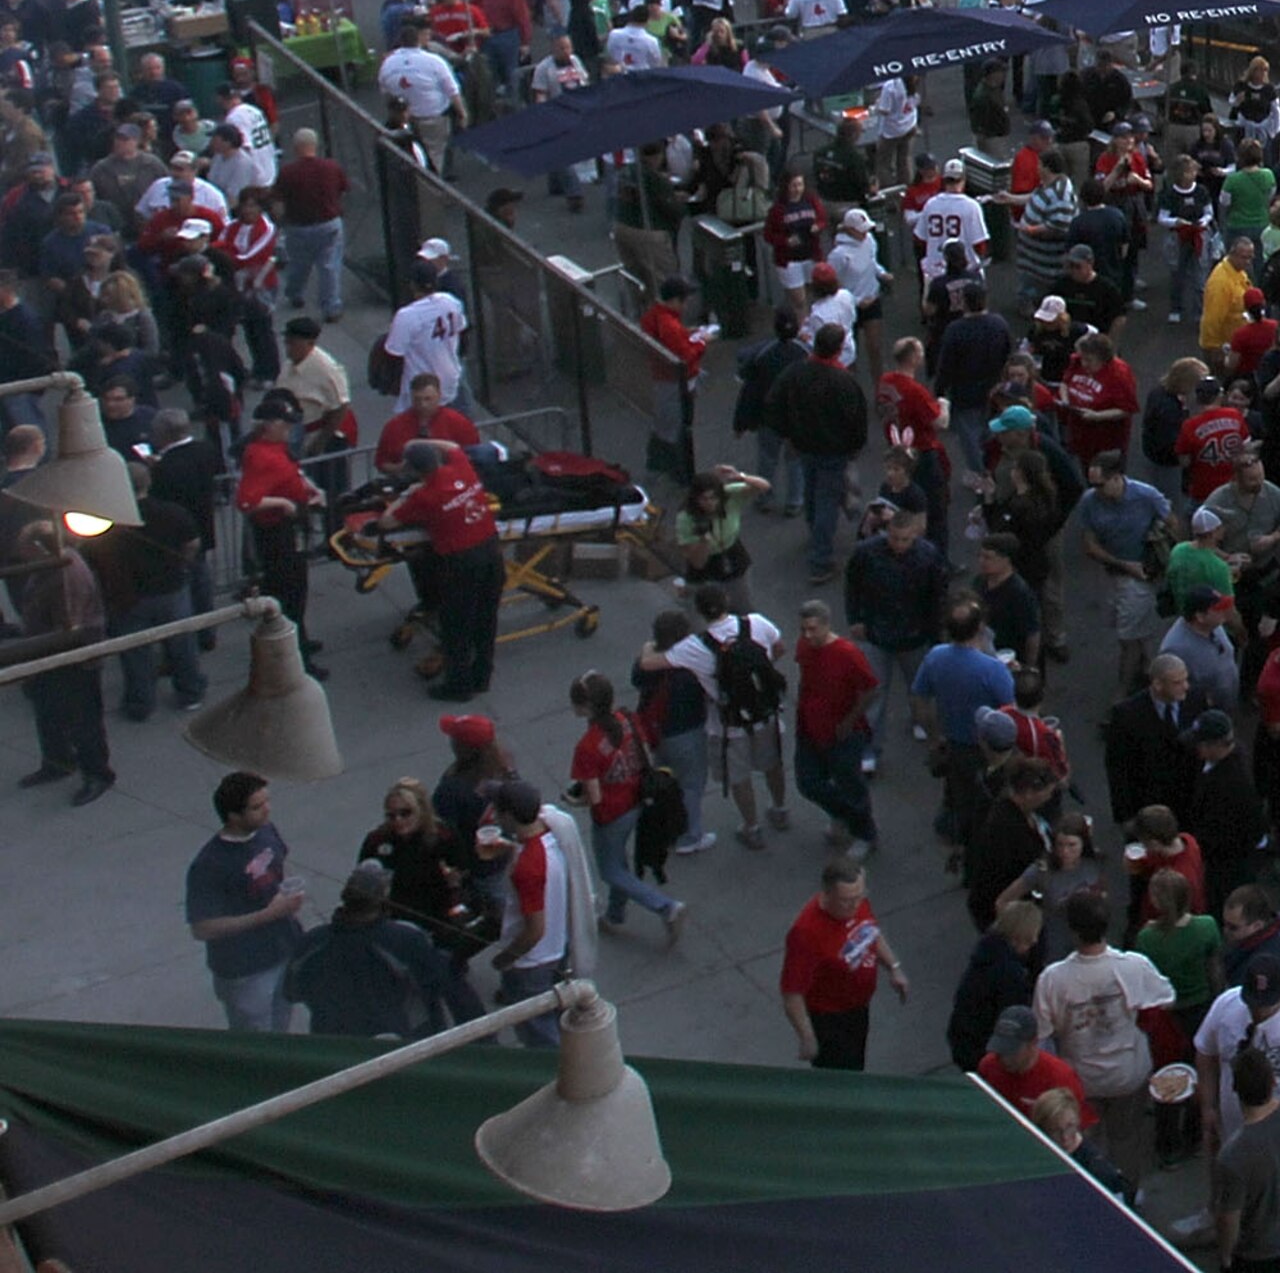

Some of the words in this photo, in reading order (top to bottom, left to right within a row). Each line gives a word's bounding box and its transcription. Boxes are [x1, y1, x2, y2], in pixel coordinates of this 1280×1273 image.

[1145, 12, 1170, 25] NO
[1177, 4, 1259, 21] RE-ENTRY
[873, 62, 904, 78] NO
[911, 38, 1008, 69] RE-ENTRY
[928, 214, 961, 238] 33
[431, 312, 460, 341] 41
